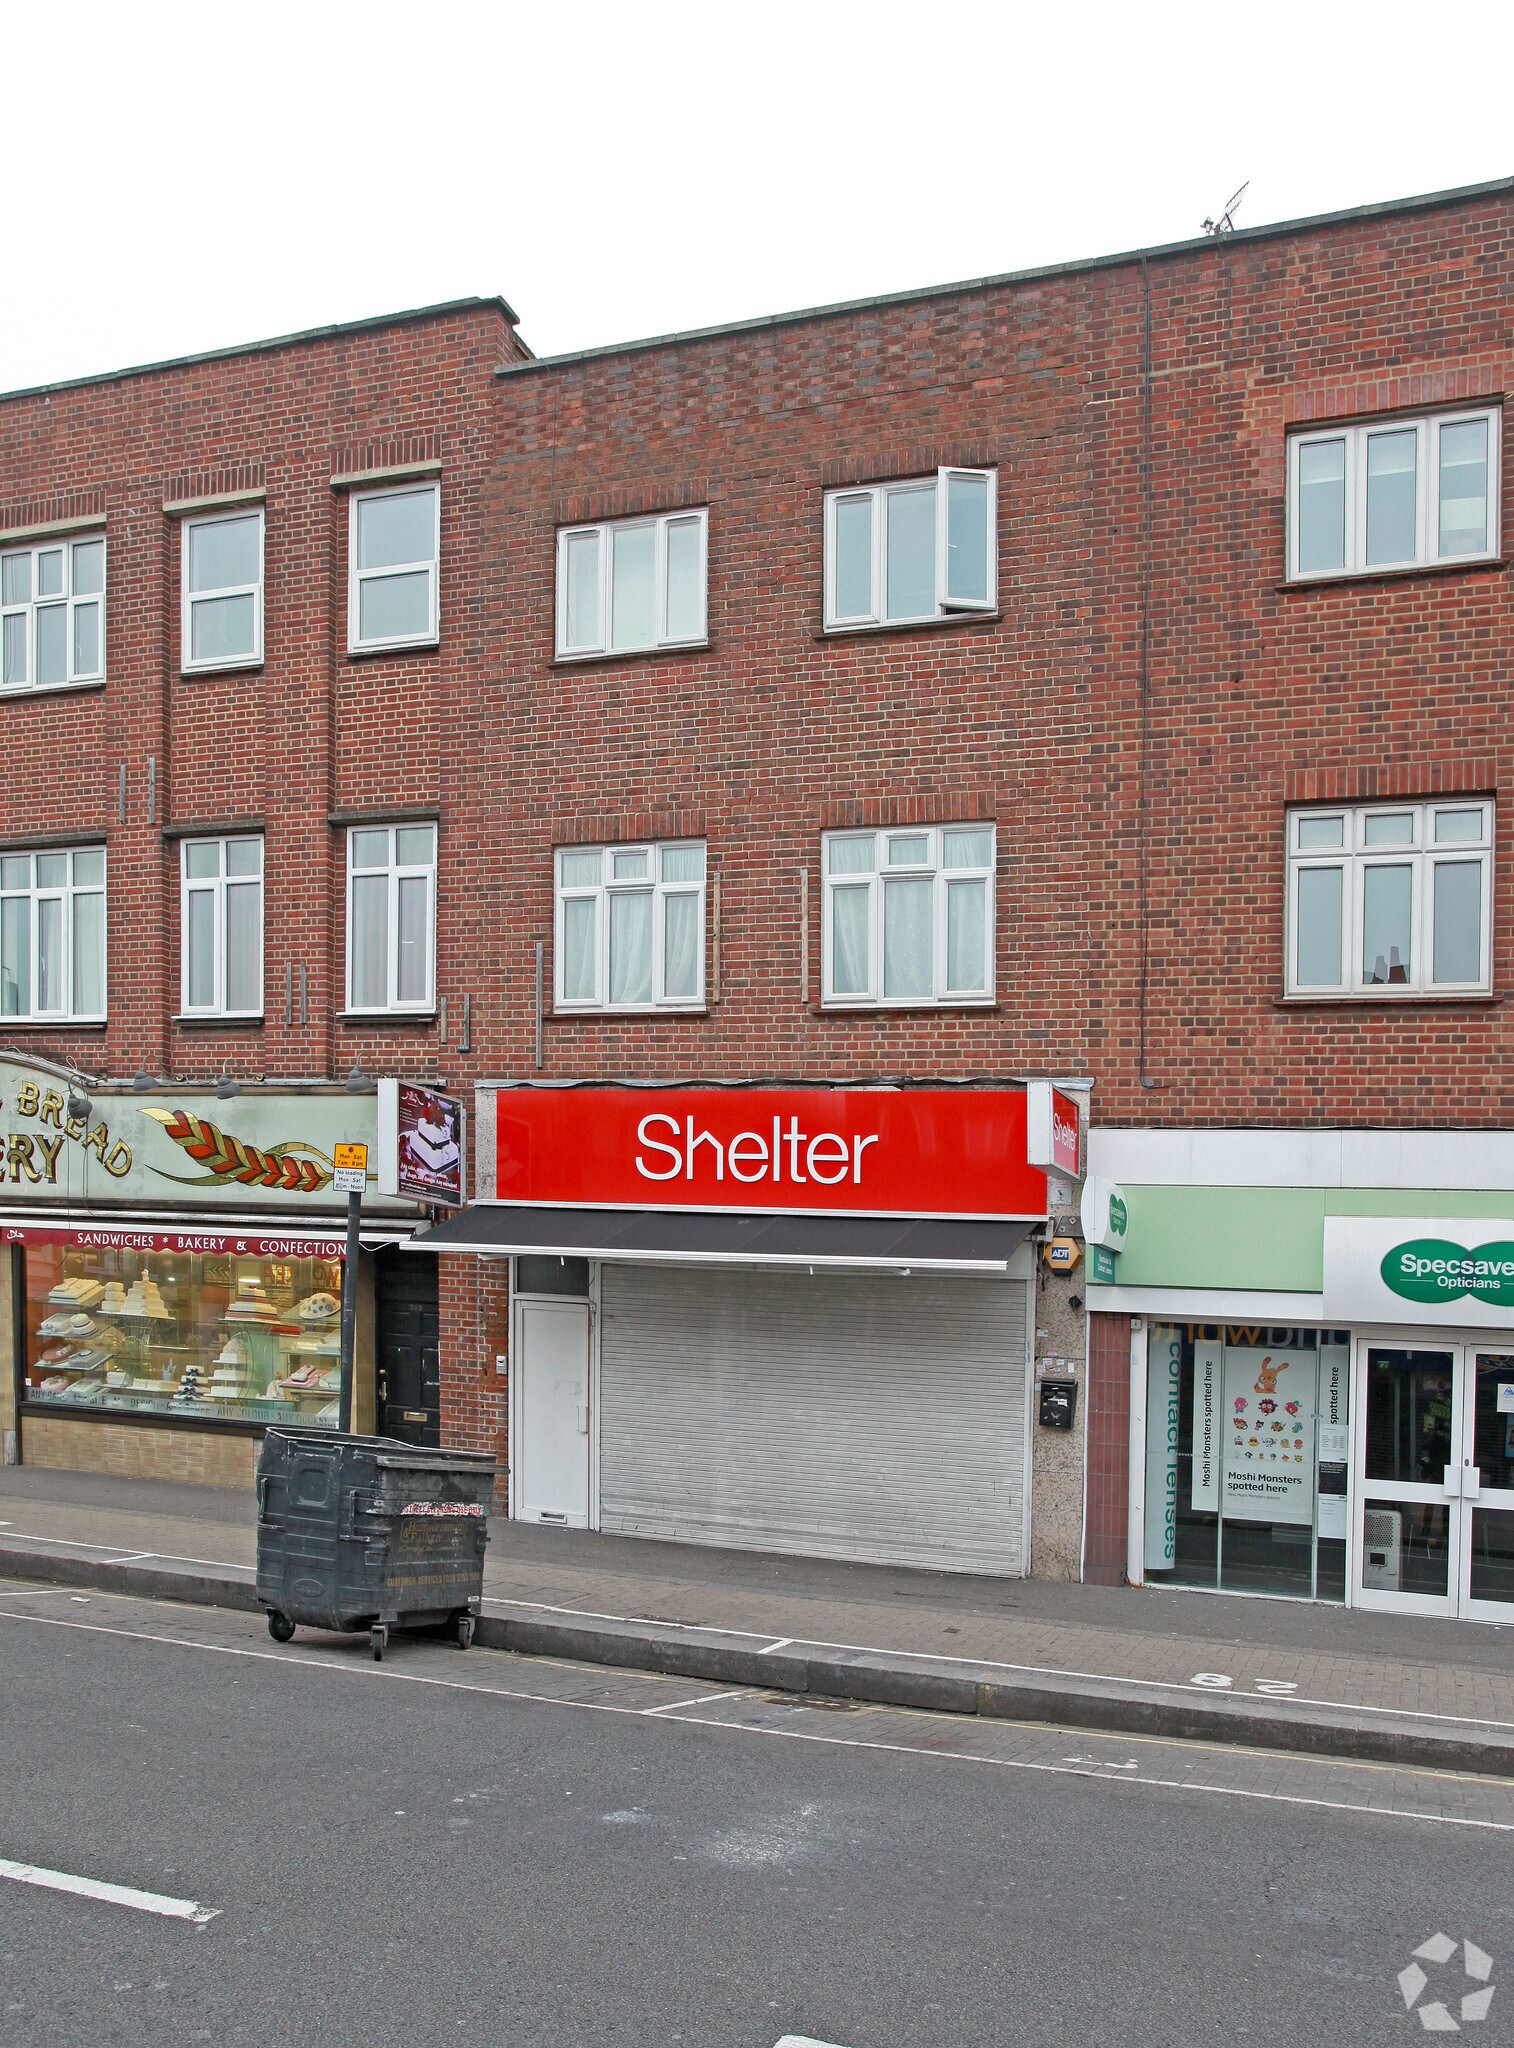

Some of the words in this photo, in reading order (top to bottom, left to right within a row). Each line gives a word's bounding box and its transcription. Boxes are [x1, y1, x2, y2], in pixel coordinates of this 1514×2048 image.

[18, 1081, 132, 1177] BREAD
[1054, 1113, 1077, 1151] Shelter
[0, 1134, 66, 1183] RY
[635, 1114, 879, 1184] Shelter
[78, 1233, 154, 1247] SANDWICHES
[178, 1237, 225, 1250] BAKERY
[236, 1241, 247, 1250] &
[1052, 1249, 1069, 1258] ADT
[1437, 1276, 1500, 1289] Opticians
[1204, 1361, 1212, 1381] here
[1330, 1366, 1339, 1388] here
[1167, 1342, 1180, 1452] contact
[1204, 1383, 1213, 1417] spotted
[1330, 1390, 1339, 1424] spotted
[1203, 1418, 1211, 1458] Monsters
[1228, 1472, 1256, 1480] Moshi
[1258, 1474, 1302, 1484] Monsters
[1228, 1482, 1263, 1491] spotted
[1266, 1484, 1288, 1493] here
[1164, 1463, 1177, 1558] lenses
